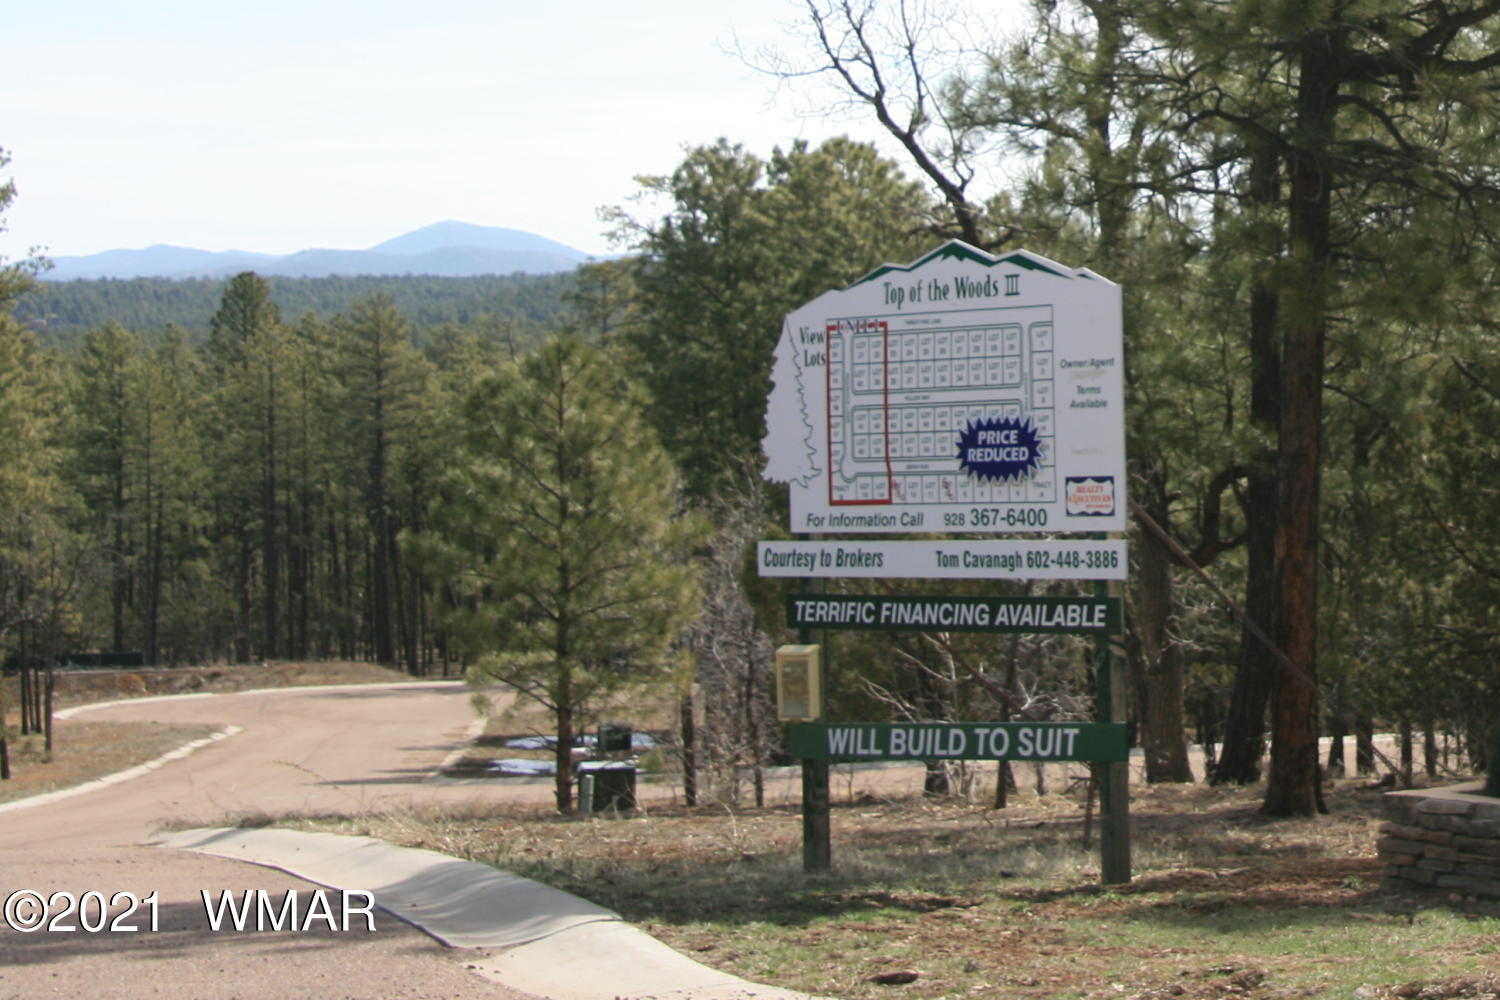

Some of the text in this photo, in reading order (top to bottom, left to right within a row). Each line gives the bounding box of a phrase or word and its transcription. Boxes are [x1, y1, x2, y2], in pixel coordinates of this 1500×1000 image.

[884, 274, 1021, 310] Top of the Woods III
[799, 327, 825, 344] View
[804, 350, 826, 367] Lots
[1077, 385, 1101, 394] Terms
[1069, 399, 1108, 408] Available
[978, 430, 1019, 446] PRICE
[967, 446, 1029, 462] REDUCED
[806, 508, 1048, 527] For Information Call 928 367-6400
[764, 548, 884, 572] Courtesy to Brokers
[936, 550, 1118, 572] Tom Cavanagh 602-448-3886
[795, 600, 1107, 627] TERRIFIC FINANCING AVAILABLE
[827, 728, 1080, 757] WILL BUILD TO SUIT
